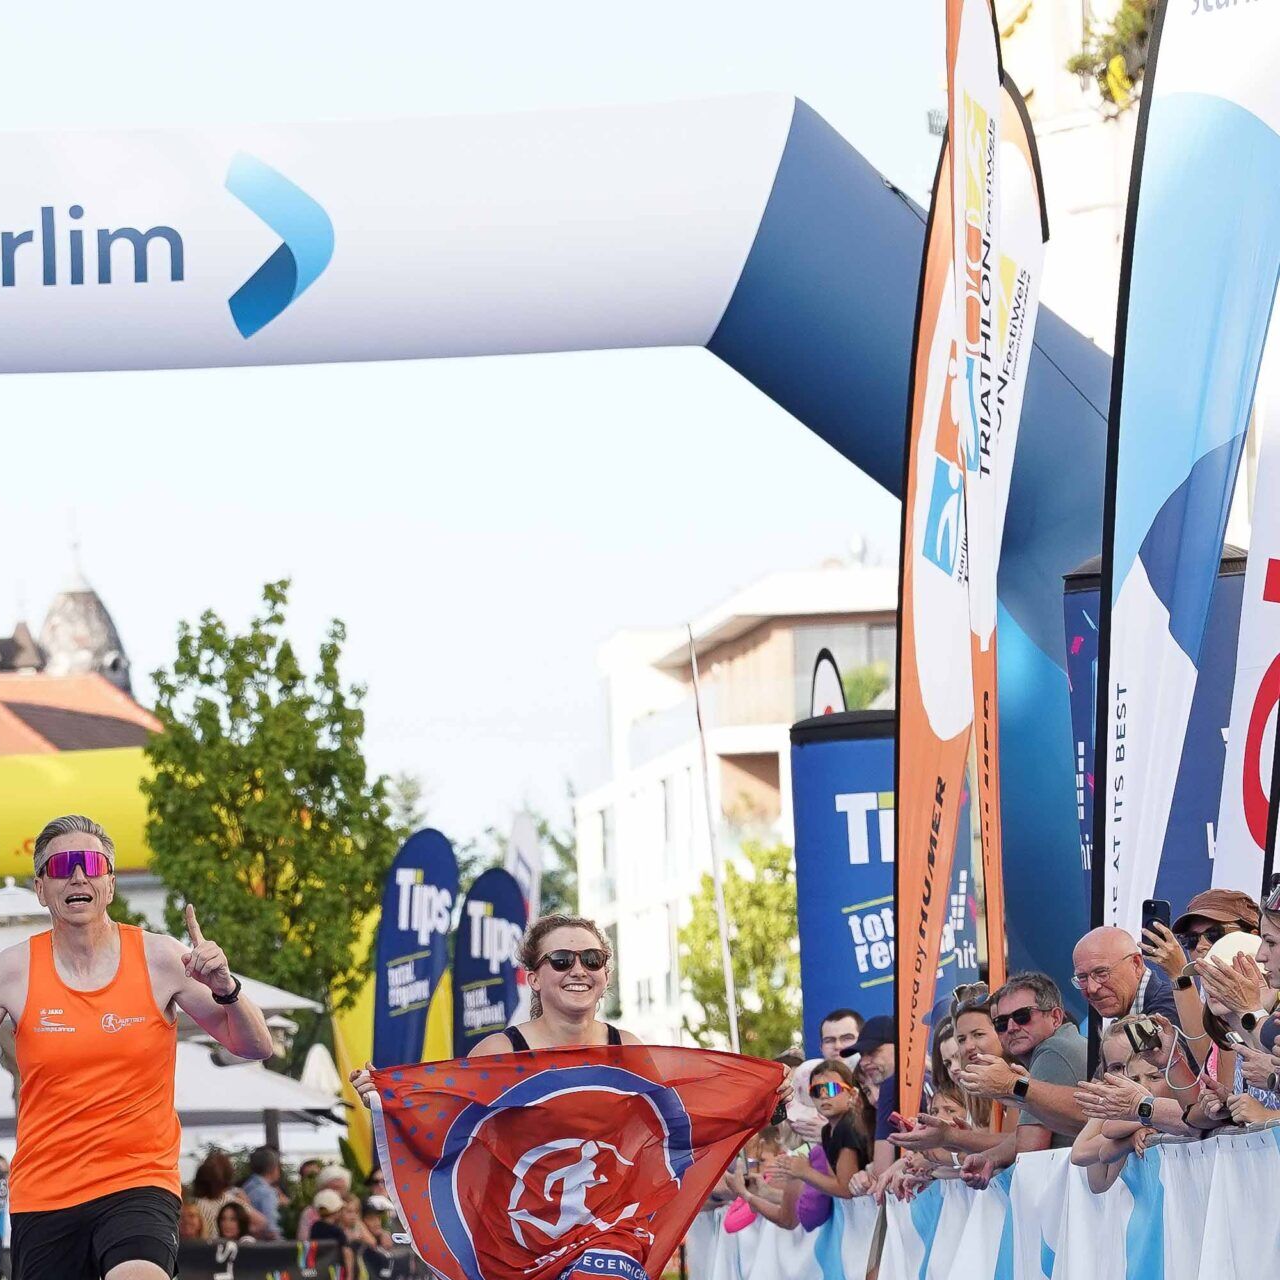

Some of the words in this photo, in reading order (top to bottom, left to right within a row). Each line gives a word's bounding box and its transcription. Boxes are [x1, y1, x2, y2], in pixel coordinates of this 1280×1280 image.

[979, 238, 992, 479] TRIATHLON
[1115, 682, 1128, 763] BEST
[918, 775, 947, 940] HUMER
[395, 867, 453, 946] Tips
[467, 900, 524, 974] Tips
[847, 906, 895, 946] tot
